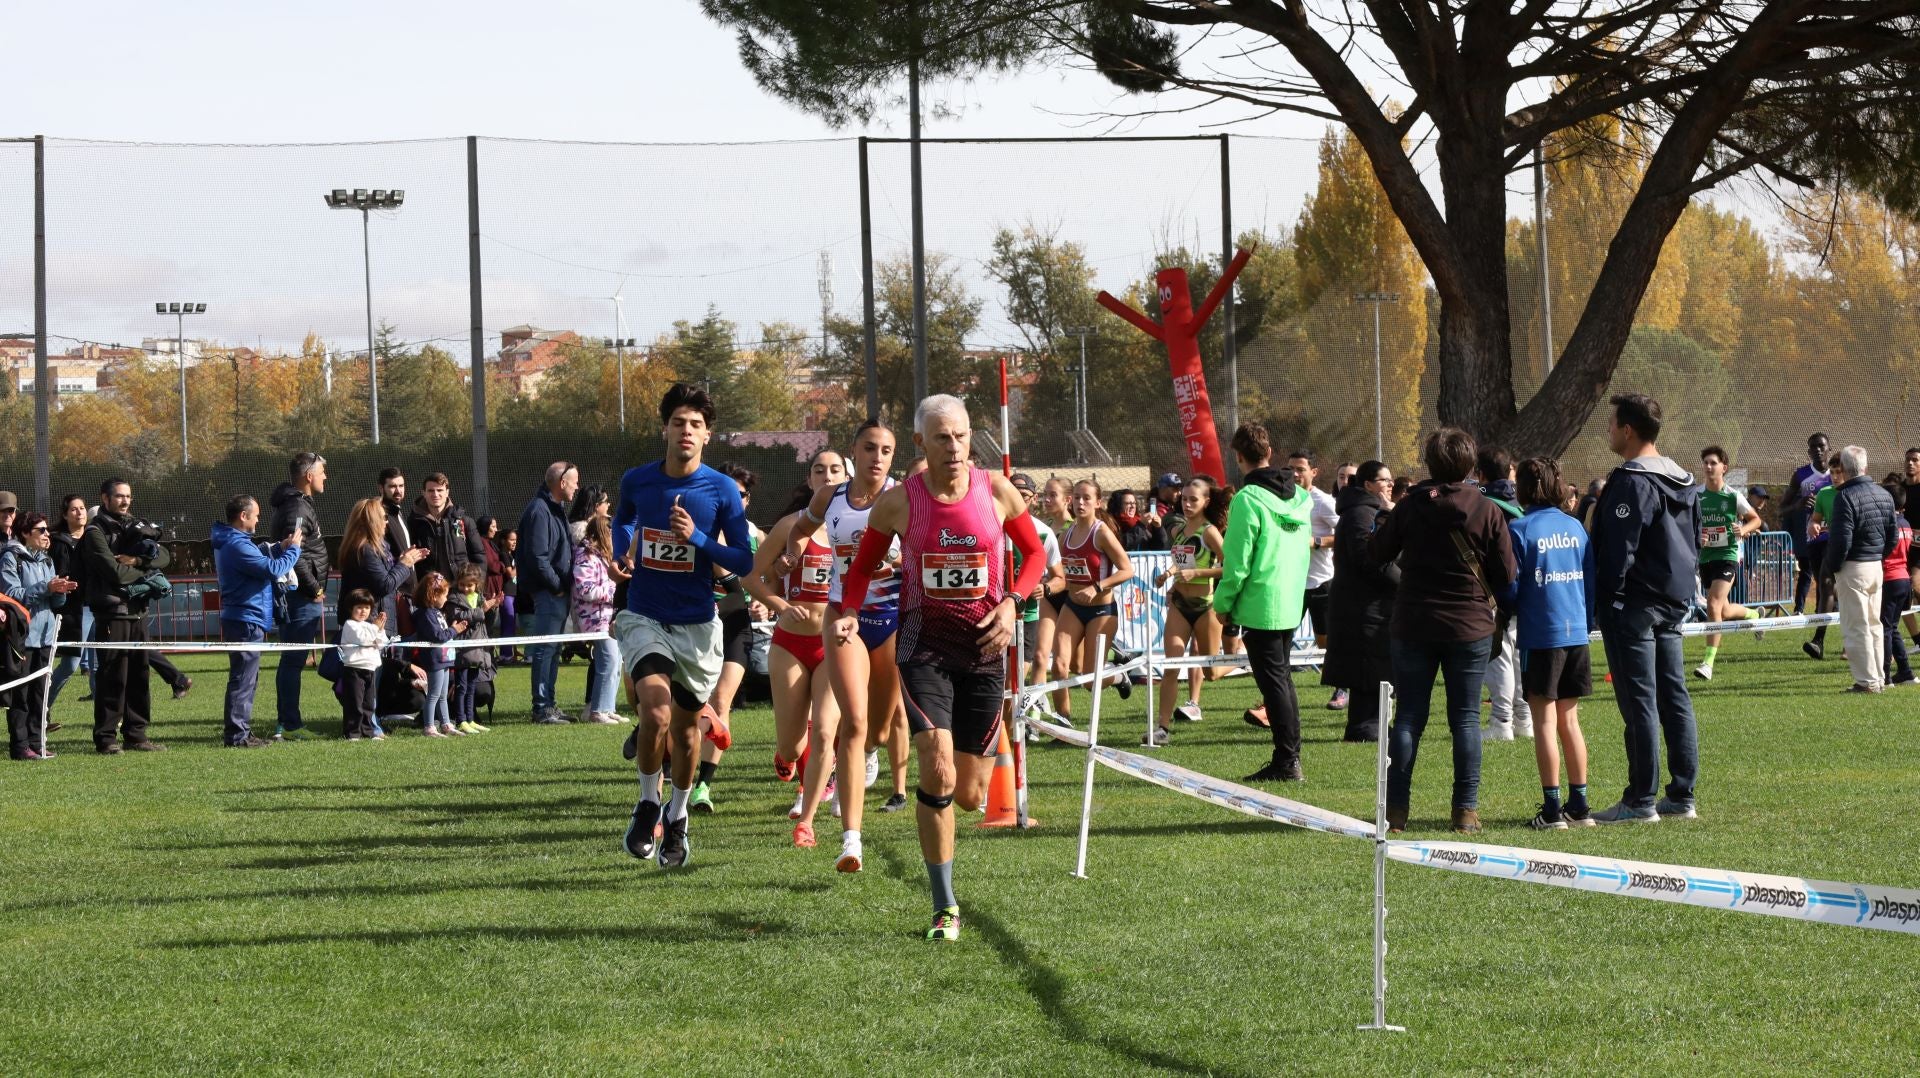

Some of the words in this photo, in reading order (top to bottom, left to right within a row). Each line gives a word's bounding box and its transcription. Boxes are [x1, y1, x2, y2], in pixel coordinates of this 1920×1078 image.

[648, 542, 689, 562] 122
[1537, 531, 1580, 554] gullón
[815, 568, 832, 583] 5
[932, 568, 981, 588] 134
[1544, 569, 1584, 585] plaspisa
[1523, 859, 1578, 880] plaspisa
[1626, 869, 1686, 894] plaspisa
[1741, 882, 1806, 909] plaspisa
